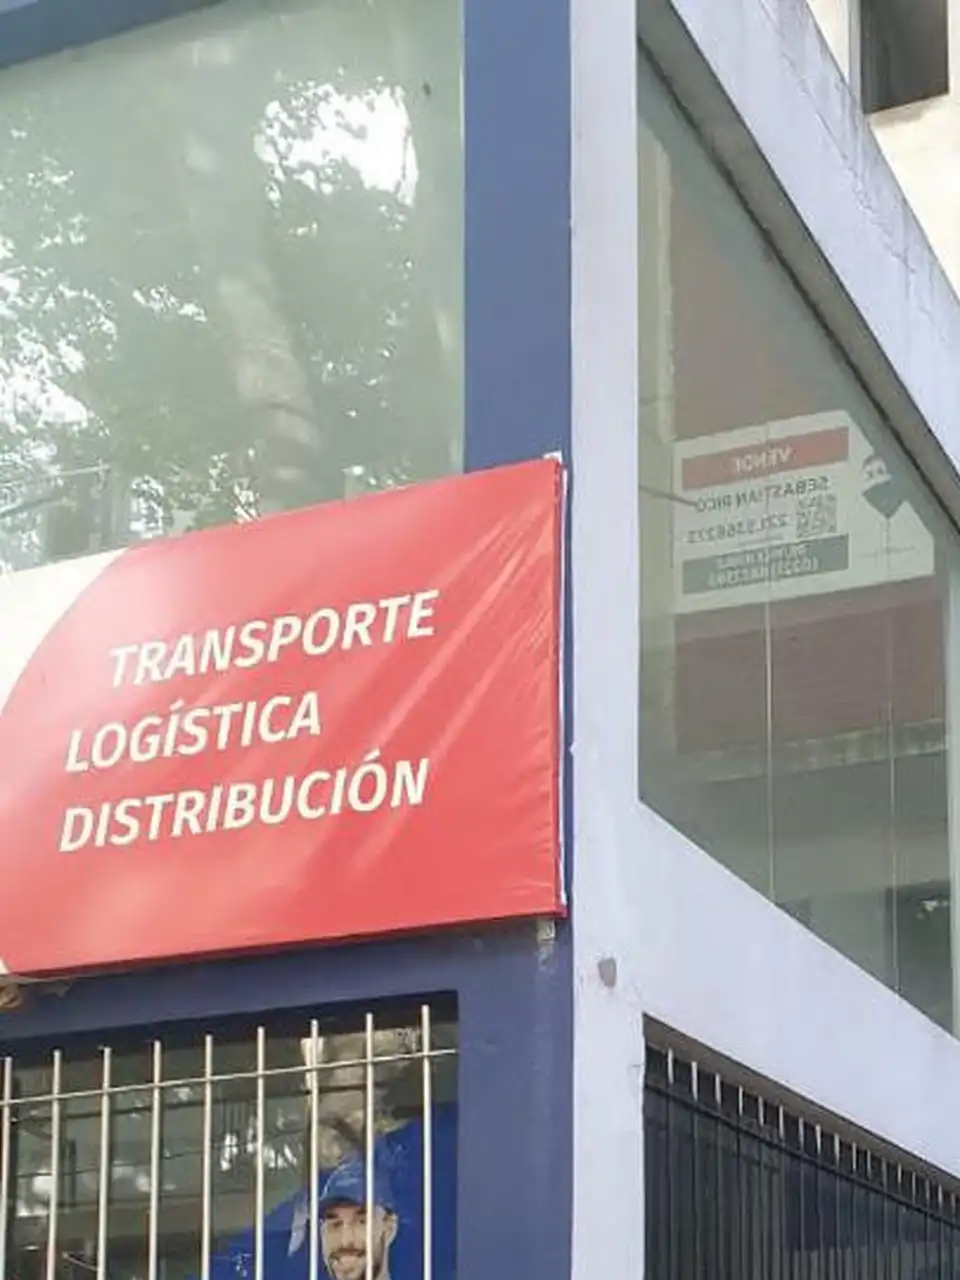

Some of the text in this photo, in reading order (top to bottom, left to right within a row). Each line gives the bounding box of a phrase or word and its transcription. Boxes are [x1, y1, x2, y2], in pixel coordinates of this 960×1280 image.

[109, 588, 440, 689] TRANSPORTE
[65, 691, 322, 774] LOGÍSTICA
[59, 748, 430, 853] DISTRIBUCIÓN
